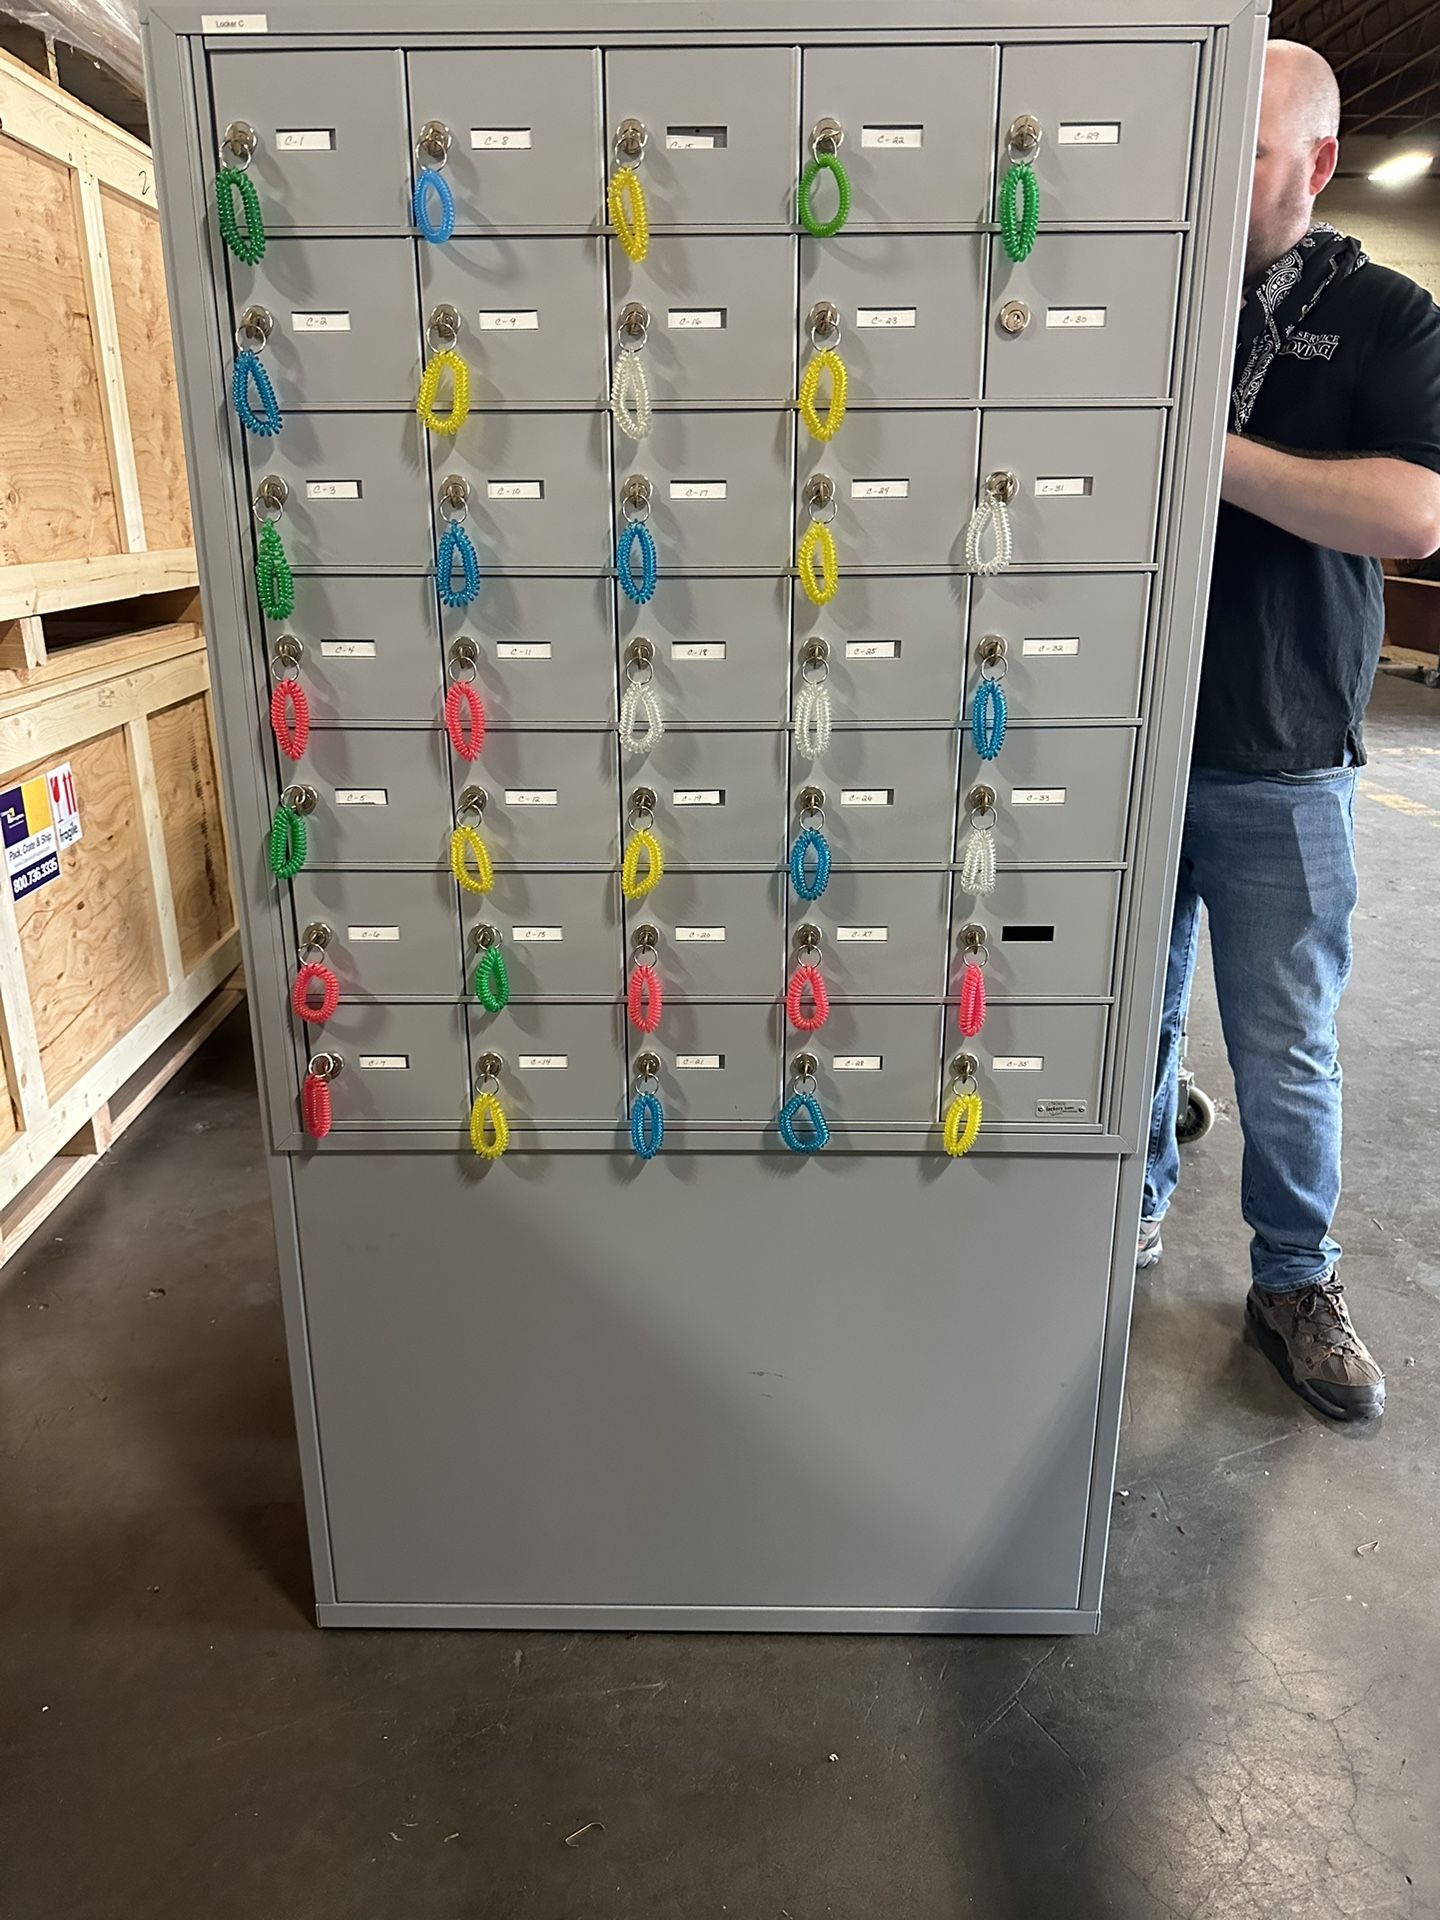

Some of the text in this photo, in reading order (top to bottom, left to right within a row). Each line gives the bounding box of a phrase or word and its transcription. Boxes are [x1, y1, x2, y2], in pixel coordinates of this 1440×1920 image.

[215, 20, 244, 28] Locker C
[285, 136, 304, 146] C-1
[484, 137, 509, 146] C-8
[877, 136, 905, 144] C-22
[1073, 133, 1100, 142] C-29
[306, 318, 327, 327] C-2
[495, 319, 516, 327] C-9
[680, 318, 702, 326] C-16
[871, 317, 898, 325] C-23
[1062, 316, 1087, 325] C-30
[1297, 331, 1340, 343] SERVICE
[1283, 340, 1331, 357] OVING
[313, 485, 336, 494] C-3
[497, 488, 521, 496] C-10
[686, 488, 709, 496] C-17
[1042, 485, 1064, 493] C-31
[335, 646, 355, 654] C-4
[510, 646, 531, 654] C-11
[518, 796, 540, 804] C-12
[59, 822, 78, 843] fragile
[41, 833, 52, 845] Ship
